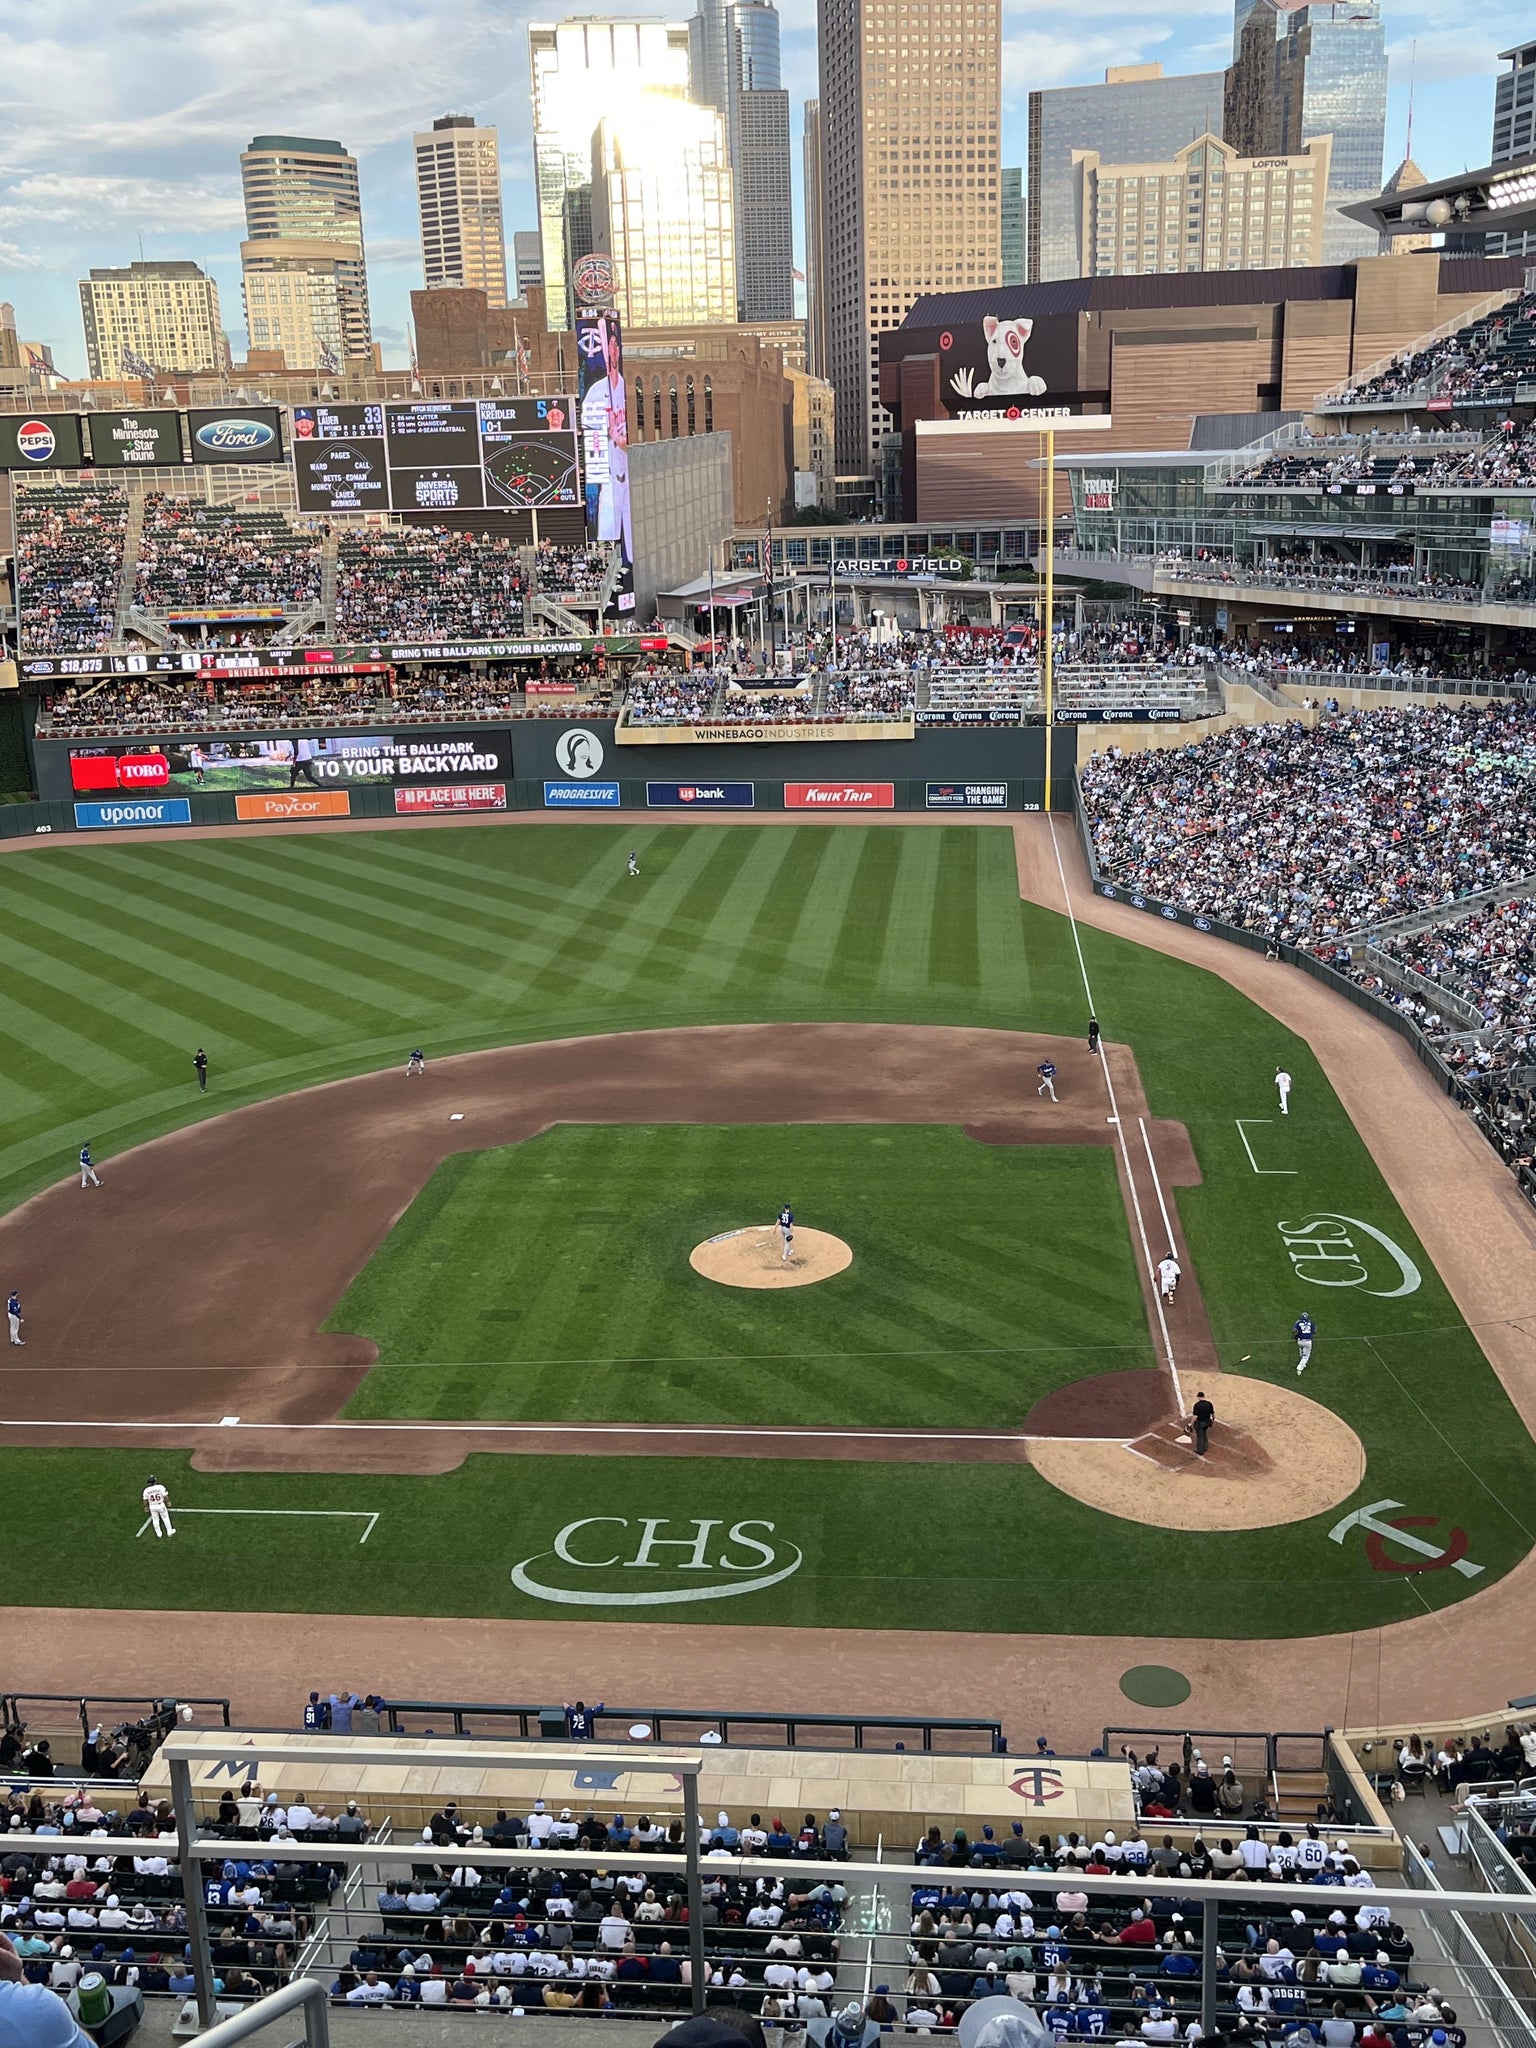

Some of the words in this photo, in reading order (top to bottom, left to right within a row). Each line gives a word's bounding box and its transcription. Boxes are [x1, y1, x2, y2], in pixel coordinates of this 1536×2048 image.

[253, 159, 288, 168] LOFTON
[480, 403, 496, 411] RYAN
[537, 401, 547, 418] 5
[364, 406, 382, 424] 33
[481, 409, 516, 419] KREIDLER
[957, 409, 1006, 421] TARGET
[1021, 407, 1070, 418] CENTER
[122, 418, 138, 429] The
[318, 416, 339, 425] LAUER
[487, 421, 501, 432] 0-1
[112, 428, 159, 440] Minnesota
[211, 420, 258, 446] Ford
[20, 436, 53, 446] PEPSI
[134, 440, 154, 451] Star
[583, 402, 610, 484] KREIDLER
[122, 450, 155, 461] Tribune
[416, 481, 458, 489] UNIVERSAL
[1083, 480, 1114, 493] TRULY
[416, 489, 458, 501] SPORTS
[827, 560, 891, 571] TARGET
[912, 560, 962, 570] FIELD
[392, 649, 420, 659] BRING
[422, 648, 441, 657] THE
[443, 646, 492, 657] BALLPARK
[494, 645, 505, 654] TO
[506, 645, 532, 654] YOUR
[533, 643, 582, 653] BACKYARD
[61, 659, 102, 673] $18,875
[134, 658, 140, 670] 1
[188, 655, 195, 668] 1
[221, 658, 225, 666] 0
[235, 658, 240, 666] 2
[229, 668, 274, 677] UNIVERSAL
[278, 666, 309, 676] SPORTS
[314, 664, 354, 673] AUCTIONS
[916, 711, 945, 722] Corona
[952, 711, 982, 722] Corona
[989, 711, 1019, 721] Corona
[1057, 710, 1087, 720] Corona
[1102, 710, 1133, 720] Corona
[1148, 709, 1179, 719] Corona
[695, 729, 764, 739] WINNEBAGO
[764, 728, 835, 739] INDUSTRIES
[342, 746, 379, 759] BRING
[382, 745, 407, 757] THE
[410, 742, 474, 755] BALLPARK
[315, 761, 340, 777] TO
[342, 758, 395, 776] YOUR
[399, 754, 499, 774] BACKYARD
[416, 789, 450, 802] PLACE
[451, 789, 468, 801] LIKE
[468, 787, 496, 800] HERE
[549, 789, 614, 800] PROGRESSIVE
[695, 788, 725, 799] bank
[965, 786, 1005, 795] CHANGING
[966, 796, 981, 804] THE
[982, 796, 1003, 804] GAME
[265, 800, 320, 814] Paycor
[100, 804, 164, 824] uponor
[36, 825, 52, 833] 403
[1277, 1221, 1368, 1286] CHS
[554, 1517, 775, 1570] CHS
[306, 1713, 315, 1723] 91
[573, 1719, 584, 1729] 72
[1128, 1852, 1144, 1862] 28
[1305, 1848, 1322, 1862] 60
[1278, 1856, 1291, 1868] 26
[1370, 1915, 1385, 1926] 26
[1044, 1953, 1059, 1966] 50
